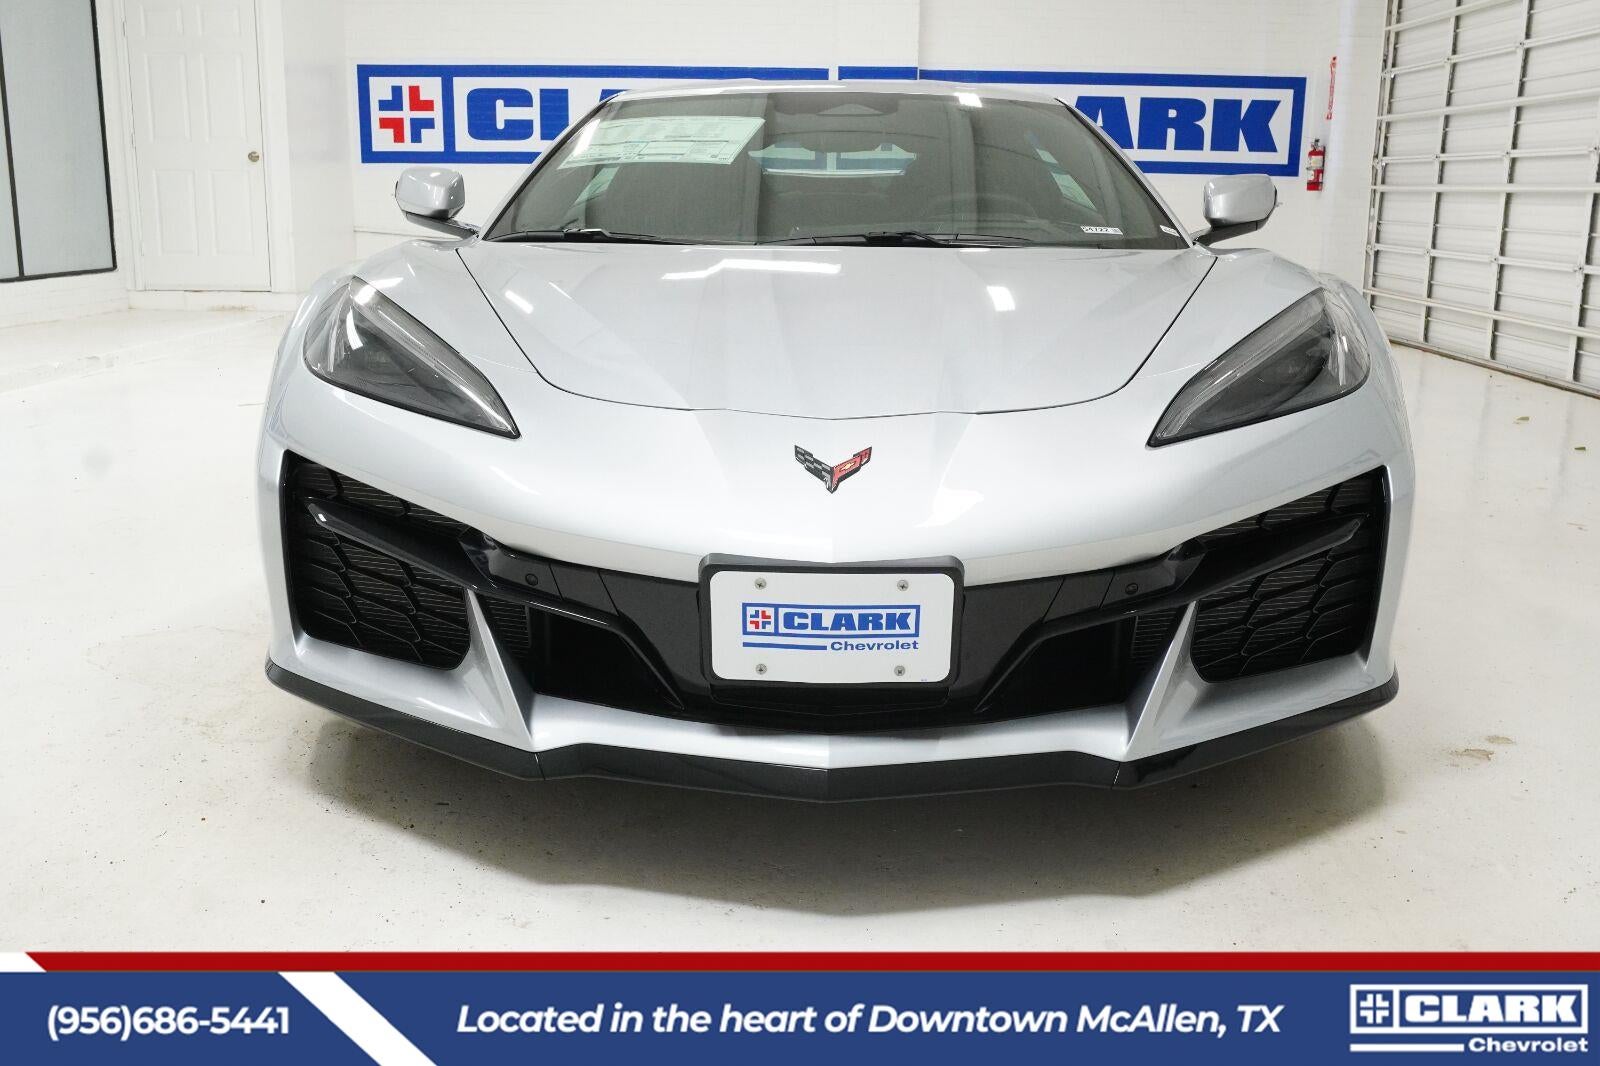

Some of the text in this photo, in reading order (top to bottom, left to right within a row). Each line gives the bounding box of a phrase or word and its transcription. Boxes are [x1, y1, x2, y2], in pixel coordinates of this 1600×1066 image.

[466, 87, 624, 140] CL
[783, 611, 911, 631] CLARK
[830, 639, 919, 651] Chevrolet
